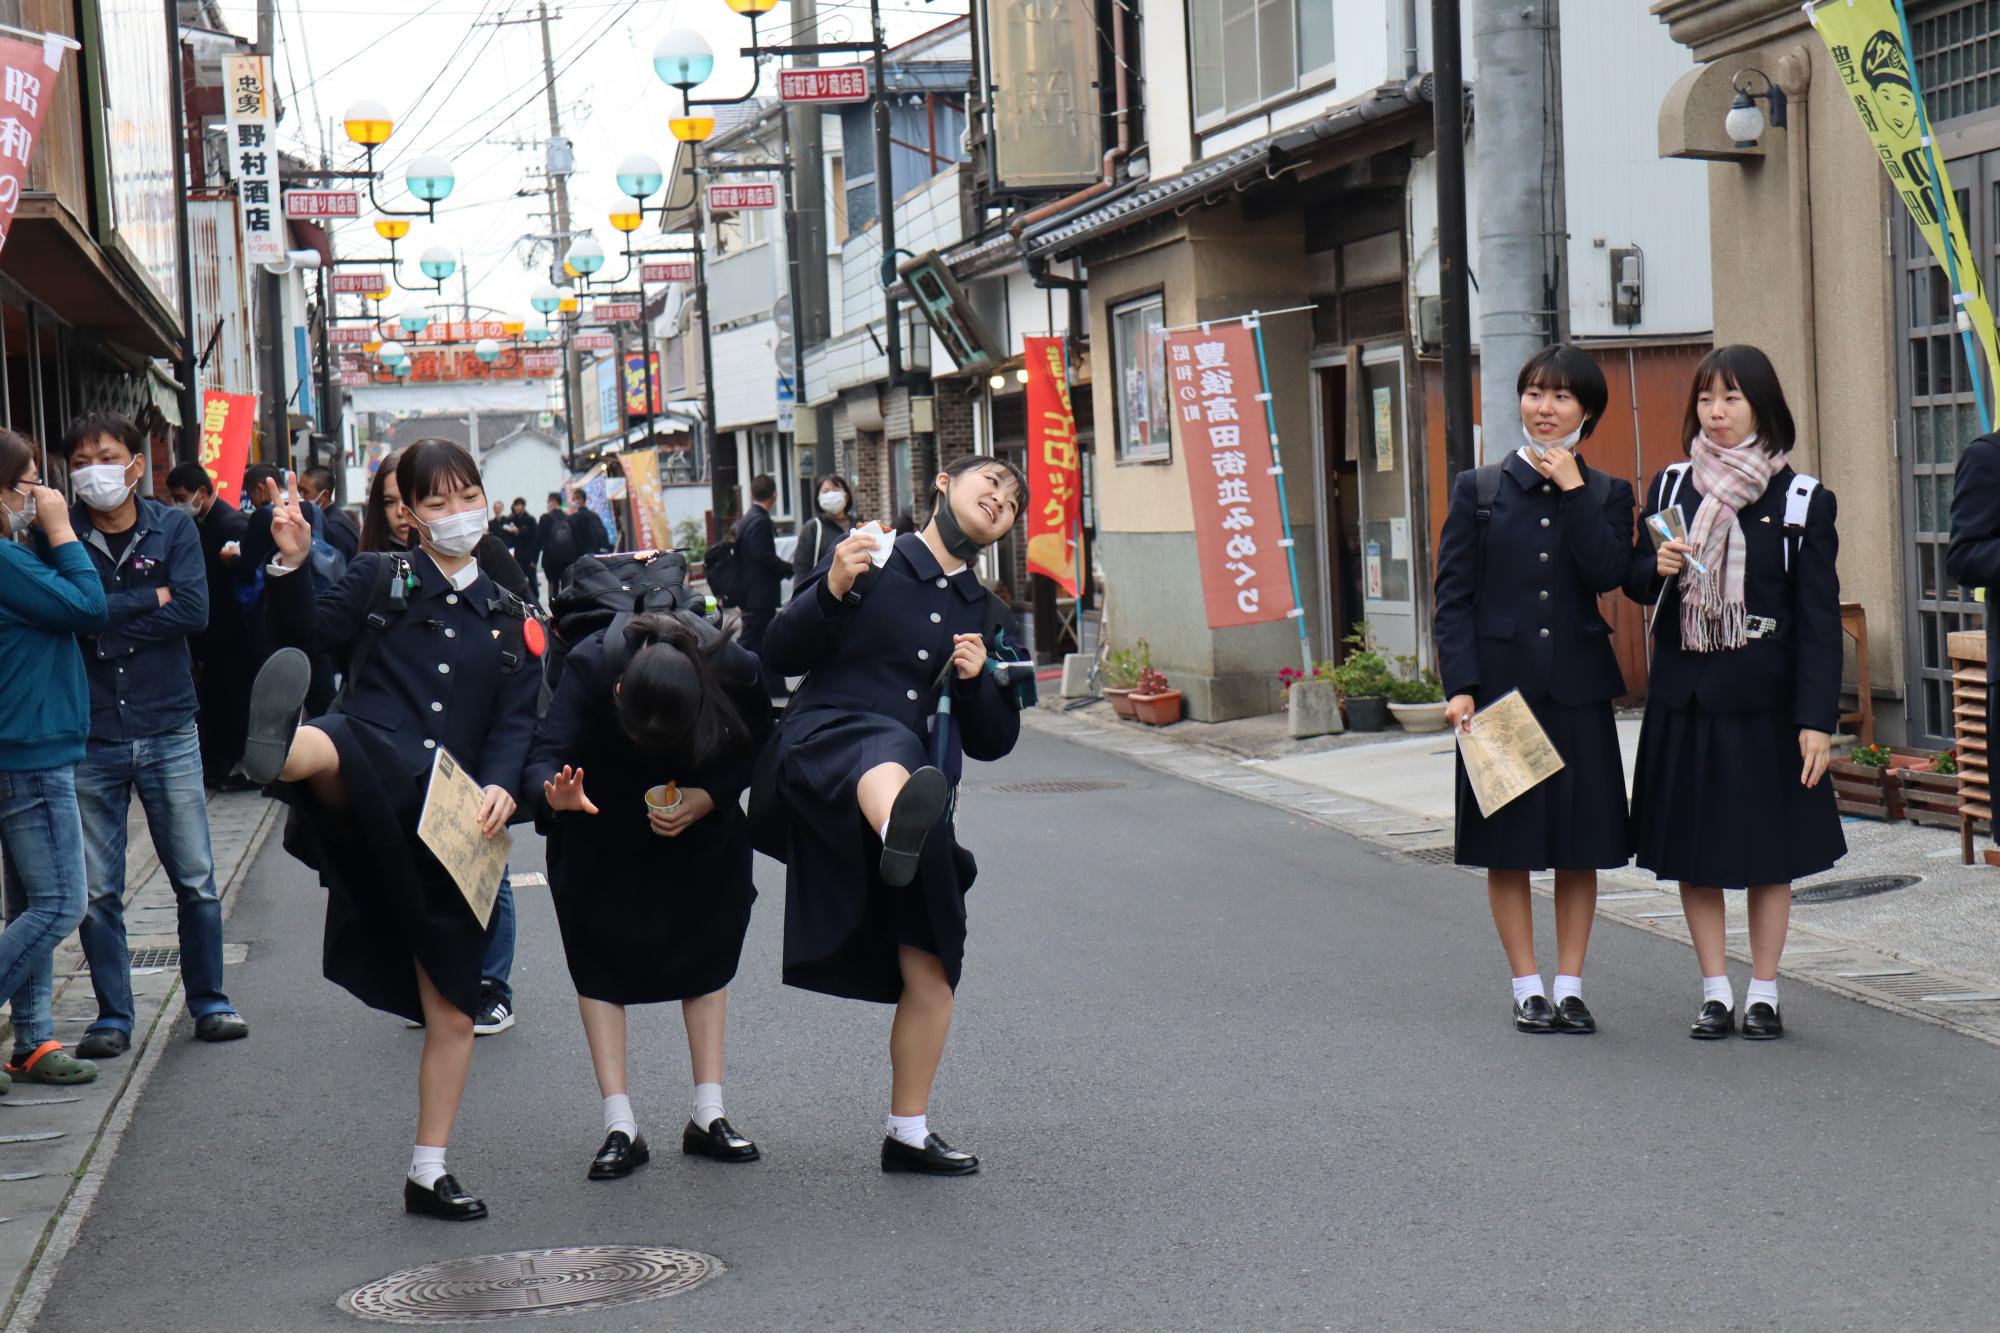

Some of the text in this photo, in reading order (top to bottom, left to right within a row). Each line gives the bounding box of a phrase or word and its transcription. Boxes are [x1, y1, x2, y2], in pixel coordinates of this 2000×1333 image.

[783, 71, 864, 97] 新町通り商店街
[0, 65, 41, 249] 昭和の
[238, 124, 270, 232] 野村酒店
[289, 195, 356, 214] 新町通り商店街
[1044, 412, 1075, 526] コロッケ
